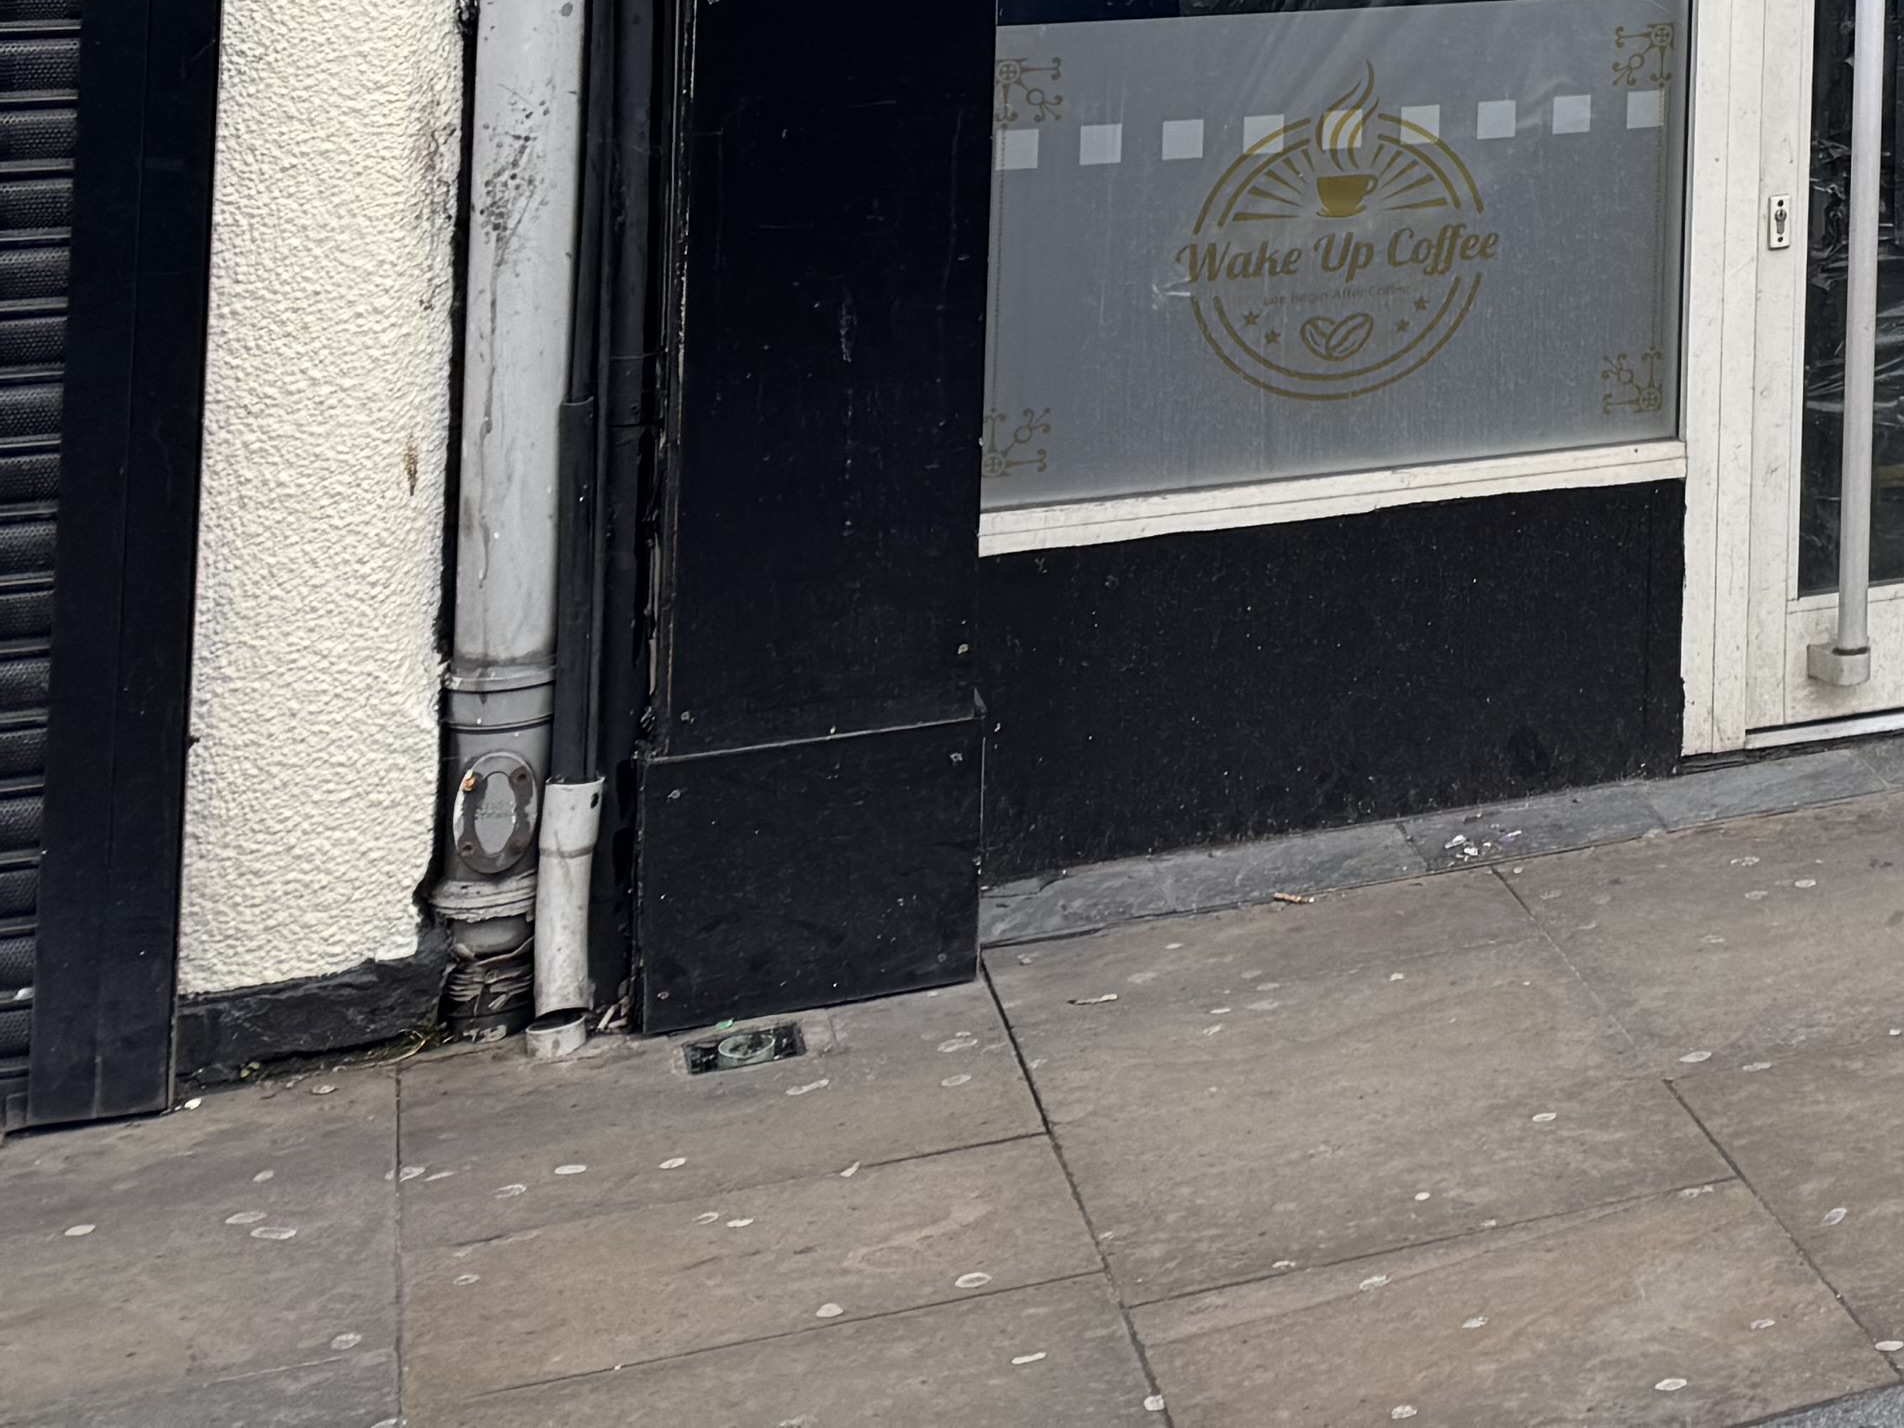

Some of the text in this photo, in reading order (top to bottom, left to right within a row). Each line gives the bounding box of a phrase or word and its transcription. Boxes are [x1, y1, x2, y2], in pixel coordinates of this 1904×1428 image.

[1174, 223, 1501, 285] Wake Up Coffee
